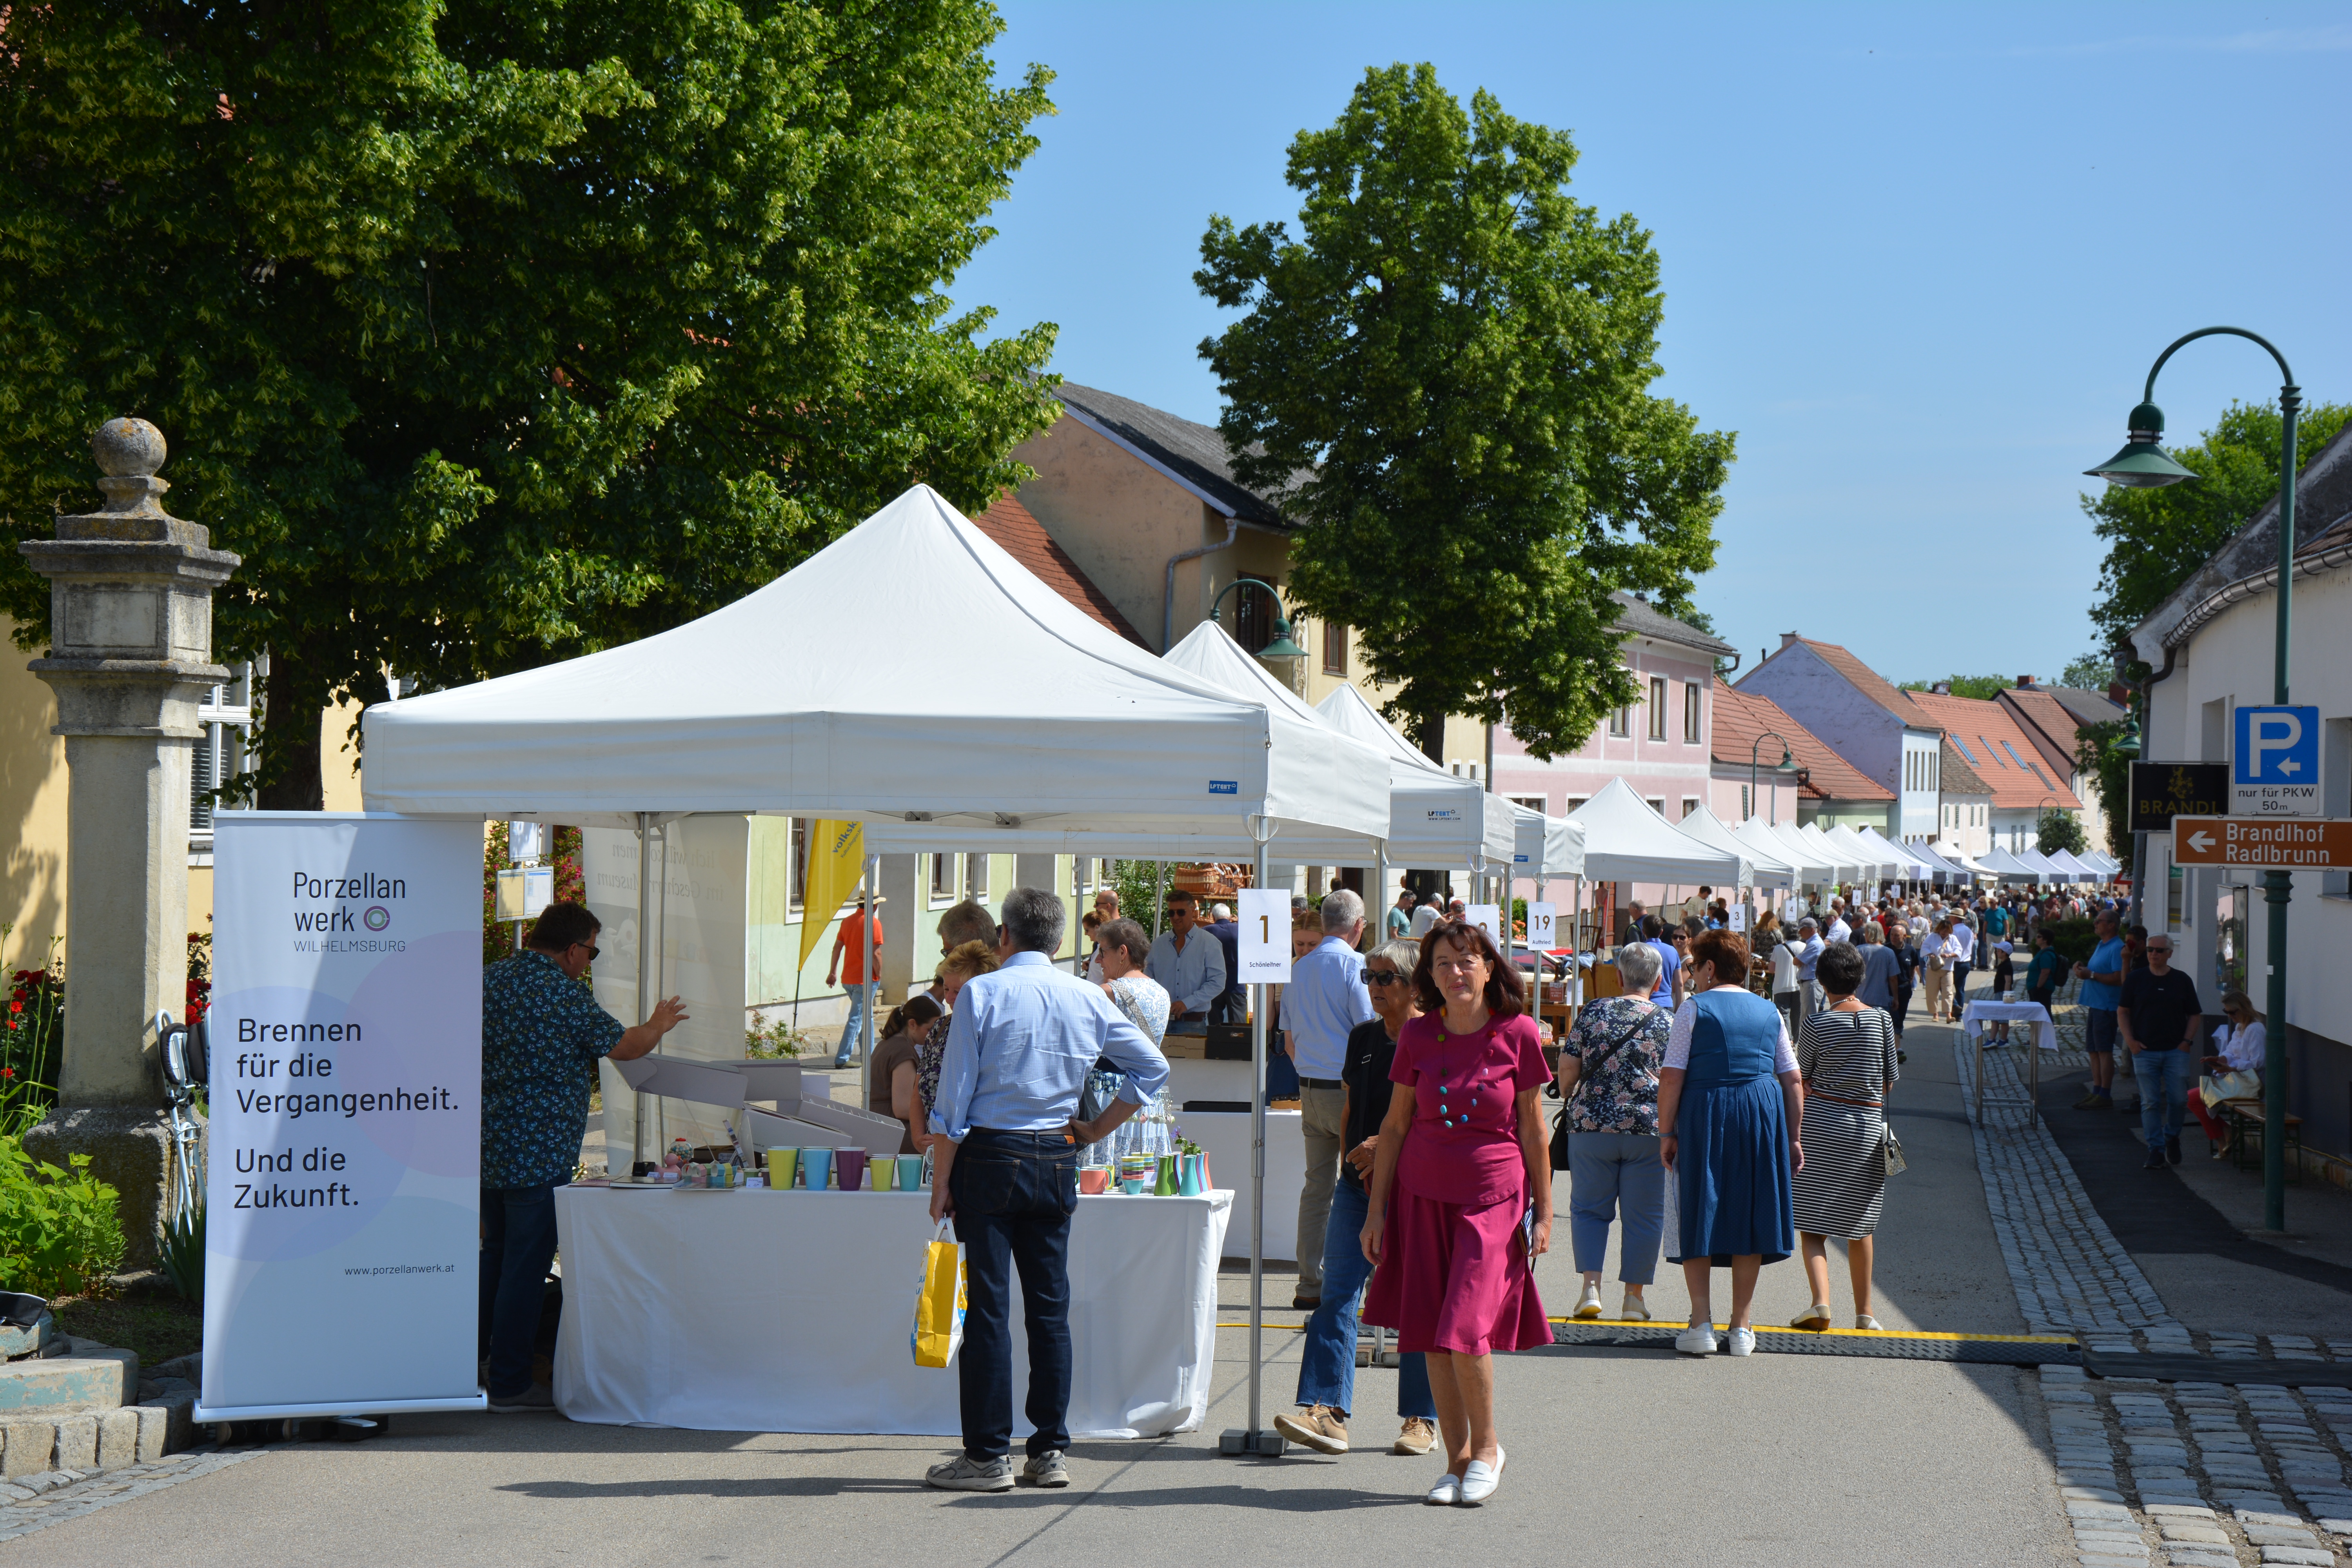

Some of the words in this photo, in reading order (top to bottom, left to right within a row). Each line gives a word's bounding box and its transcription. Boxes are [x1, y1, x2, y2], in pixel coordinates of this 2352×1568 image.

[2249, 713, 2302, 777] P
[2262, 788, 2279, 797] für
[2140, 800, 2221, 815] BRANDL
[832, 821, 858, 853] volksk
[2227, 823, 2324, 842] Brandlhof
[2226, 844, 2329, 863] Radlbrunn
[294, 872, 406, 898] Porzellan
[294, 906, 355, 932] werk
[1534, 915, 1550, 930] 19
[1735, 912, 1740, 920] 3
[1259, 915, 1268, 944] 1
[294, 941, 406, 952] WILHELMSBURG
[238, 1018, 361, 1042] Brennen
[237, 1053, 280, 1078] für
[289, 1053, 332, 1077] die
[236, 1086, 459, 1119] Vergangenheit.
[236, 1148, 292, 1173] Und
[302, 1147, 346, 1171] die
[234, 1182, 359, 1209] Zukunft.
[345, 1264, 455, 1276] www.porzellanwerk.at
